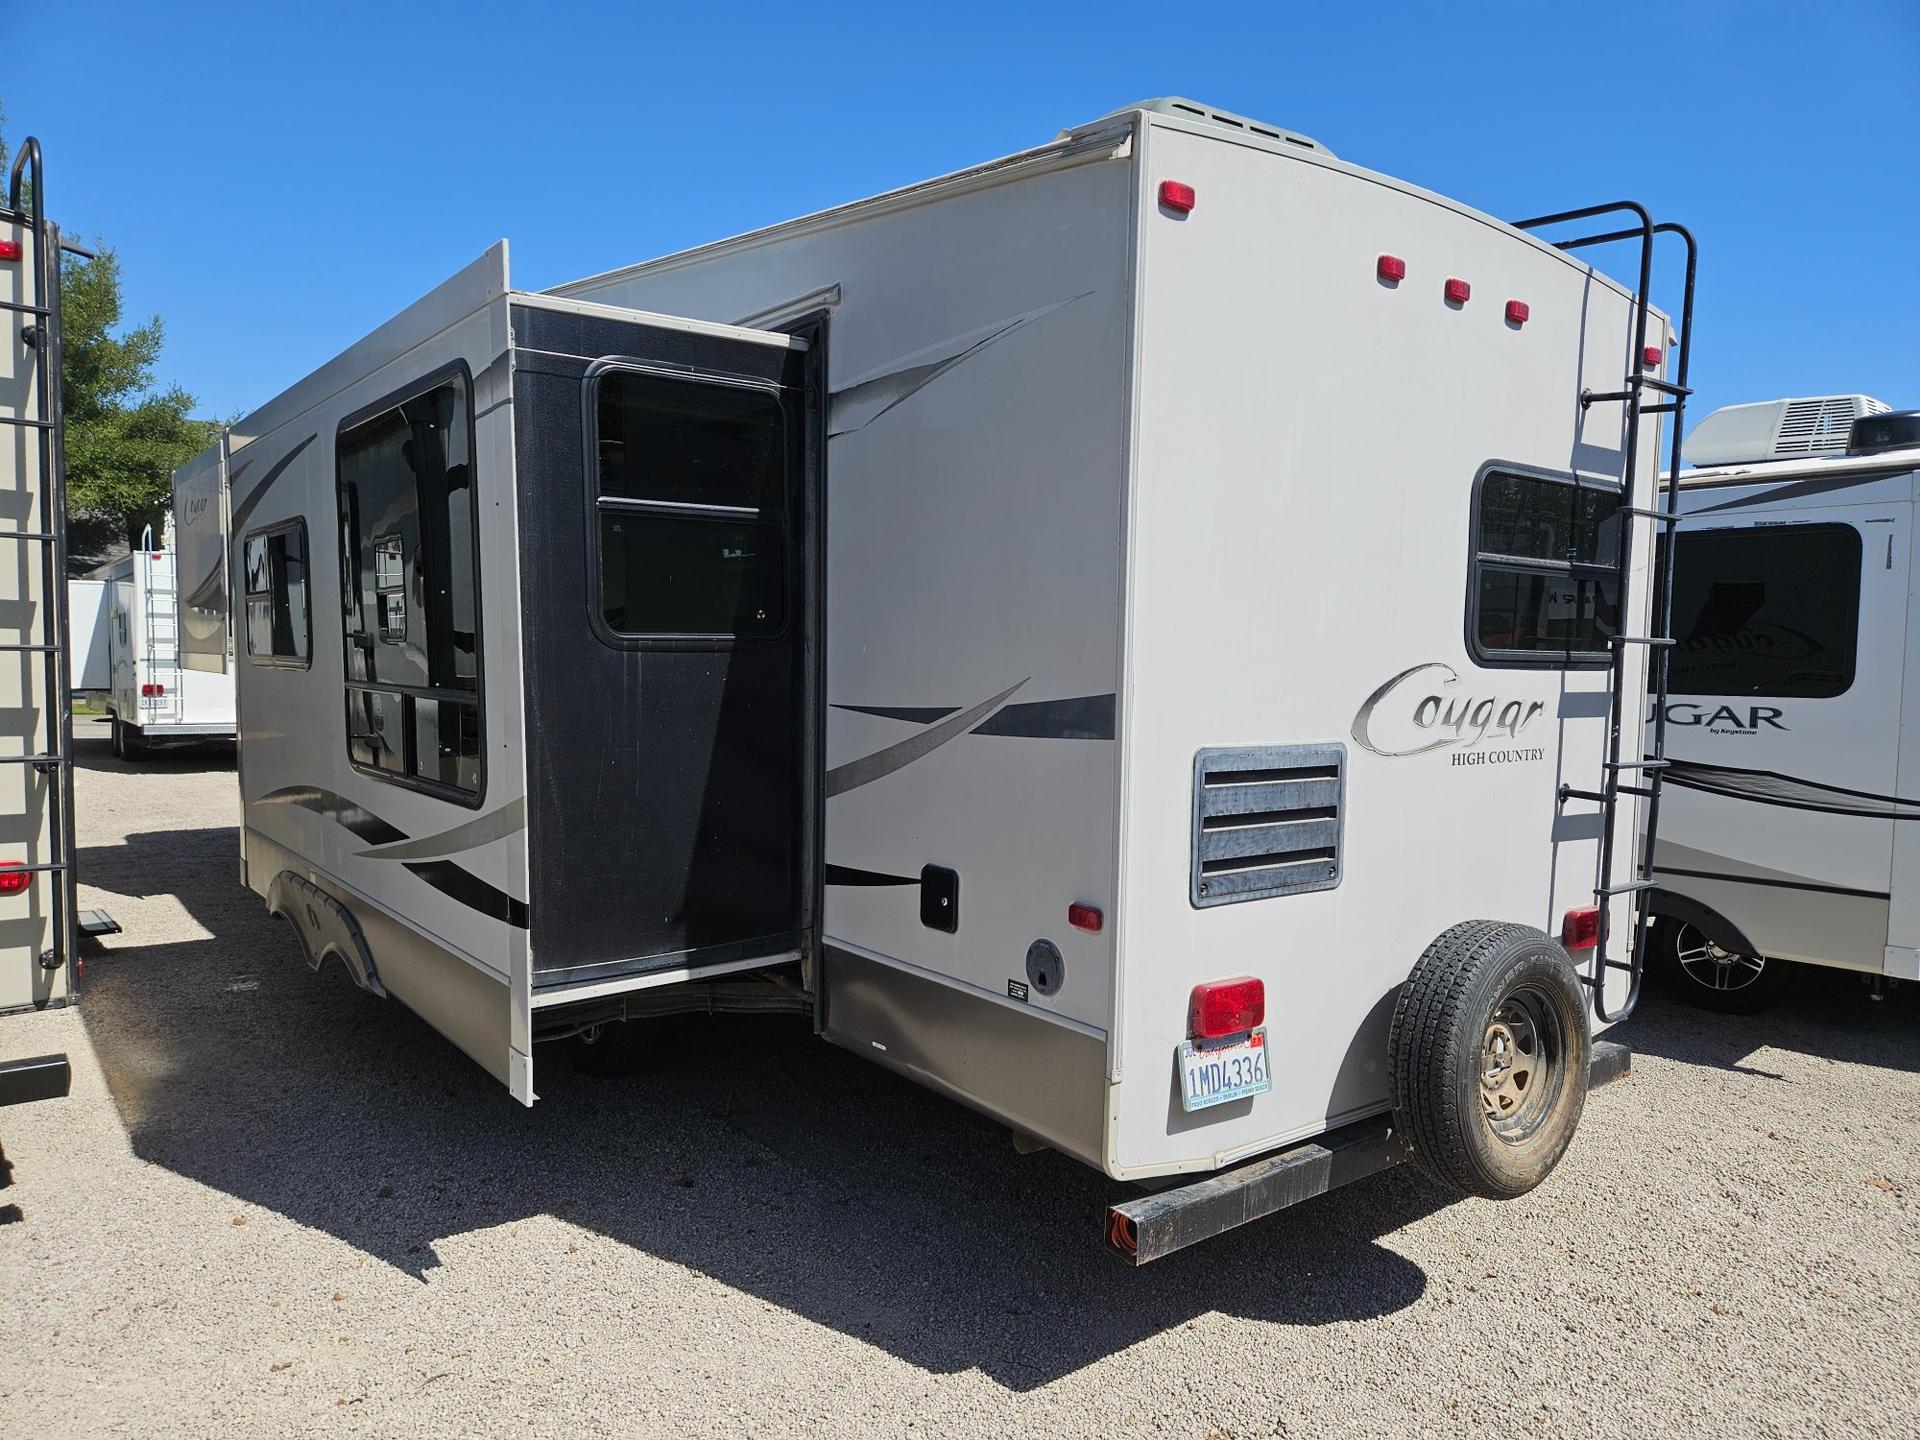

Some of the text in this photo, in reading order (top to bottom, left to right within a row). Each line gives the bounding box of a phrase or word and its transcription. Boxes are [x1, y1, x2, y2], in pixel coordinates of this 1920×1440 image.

[1351, 663, 1545, 757] Cougar
[1709, 727, 1720, 735] by
[1451, 748, 1545, 766] HIGH COUNTRY
[1188, 1052, 1264, 1099] 1MD4336
